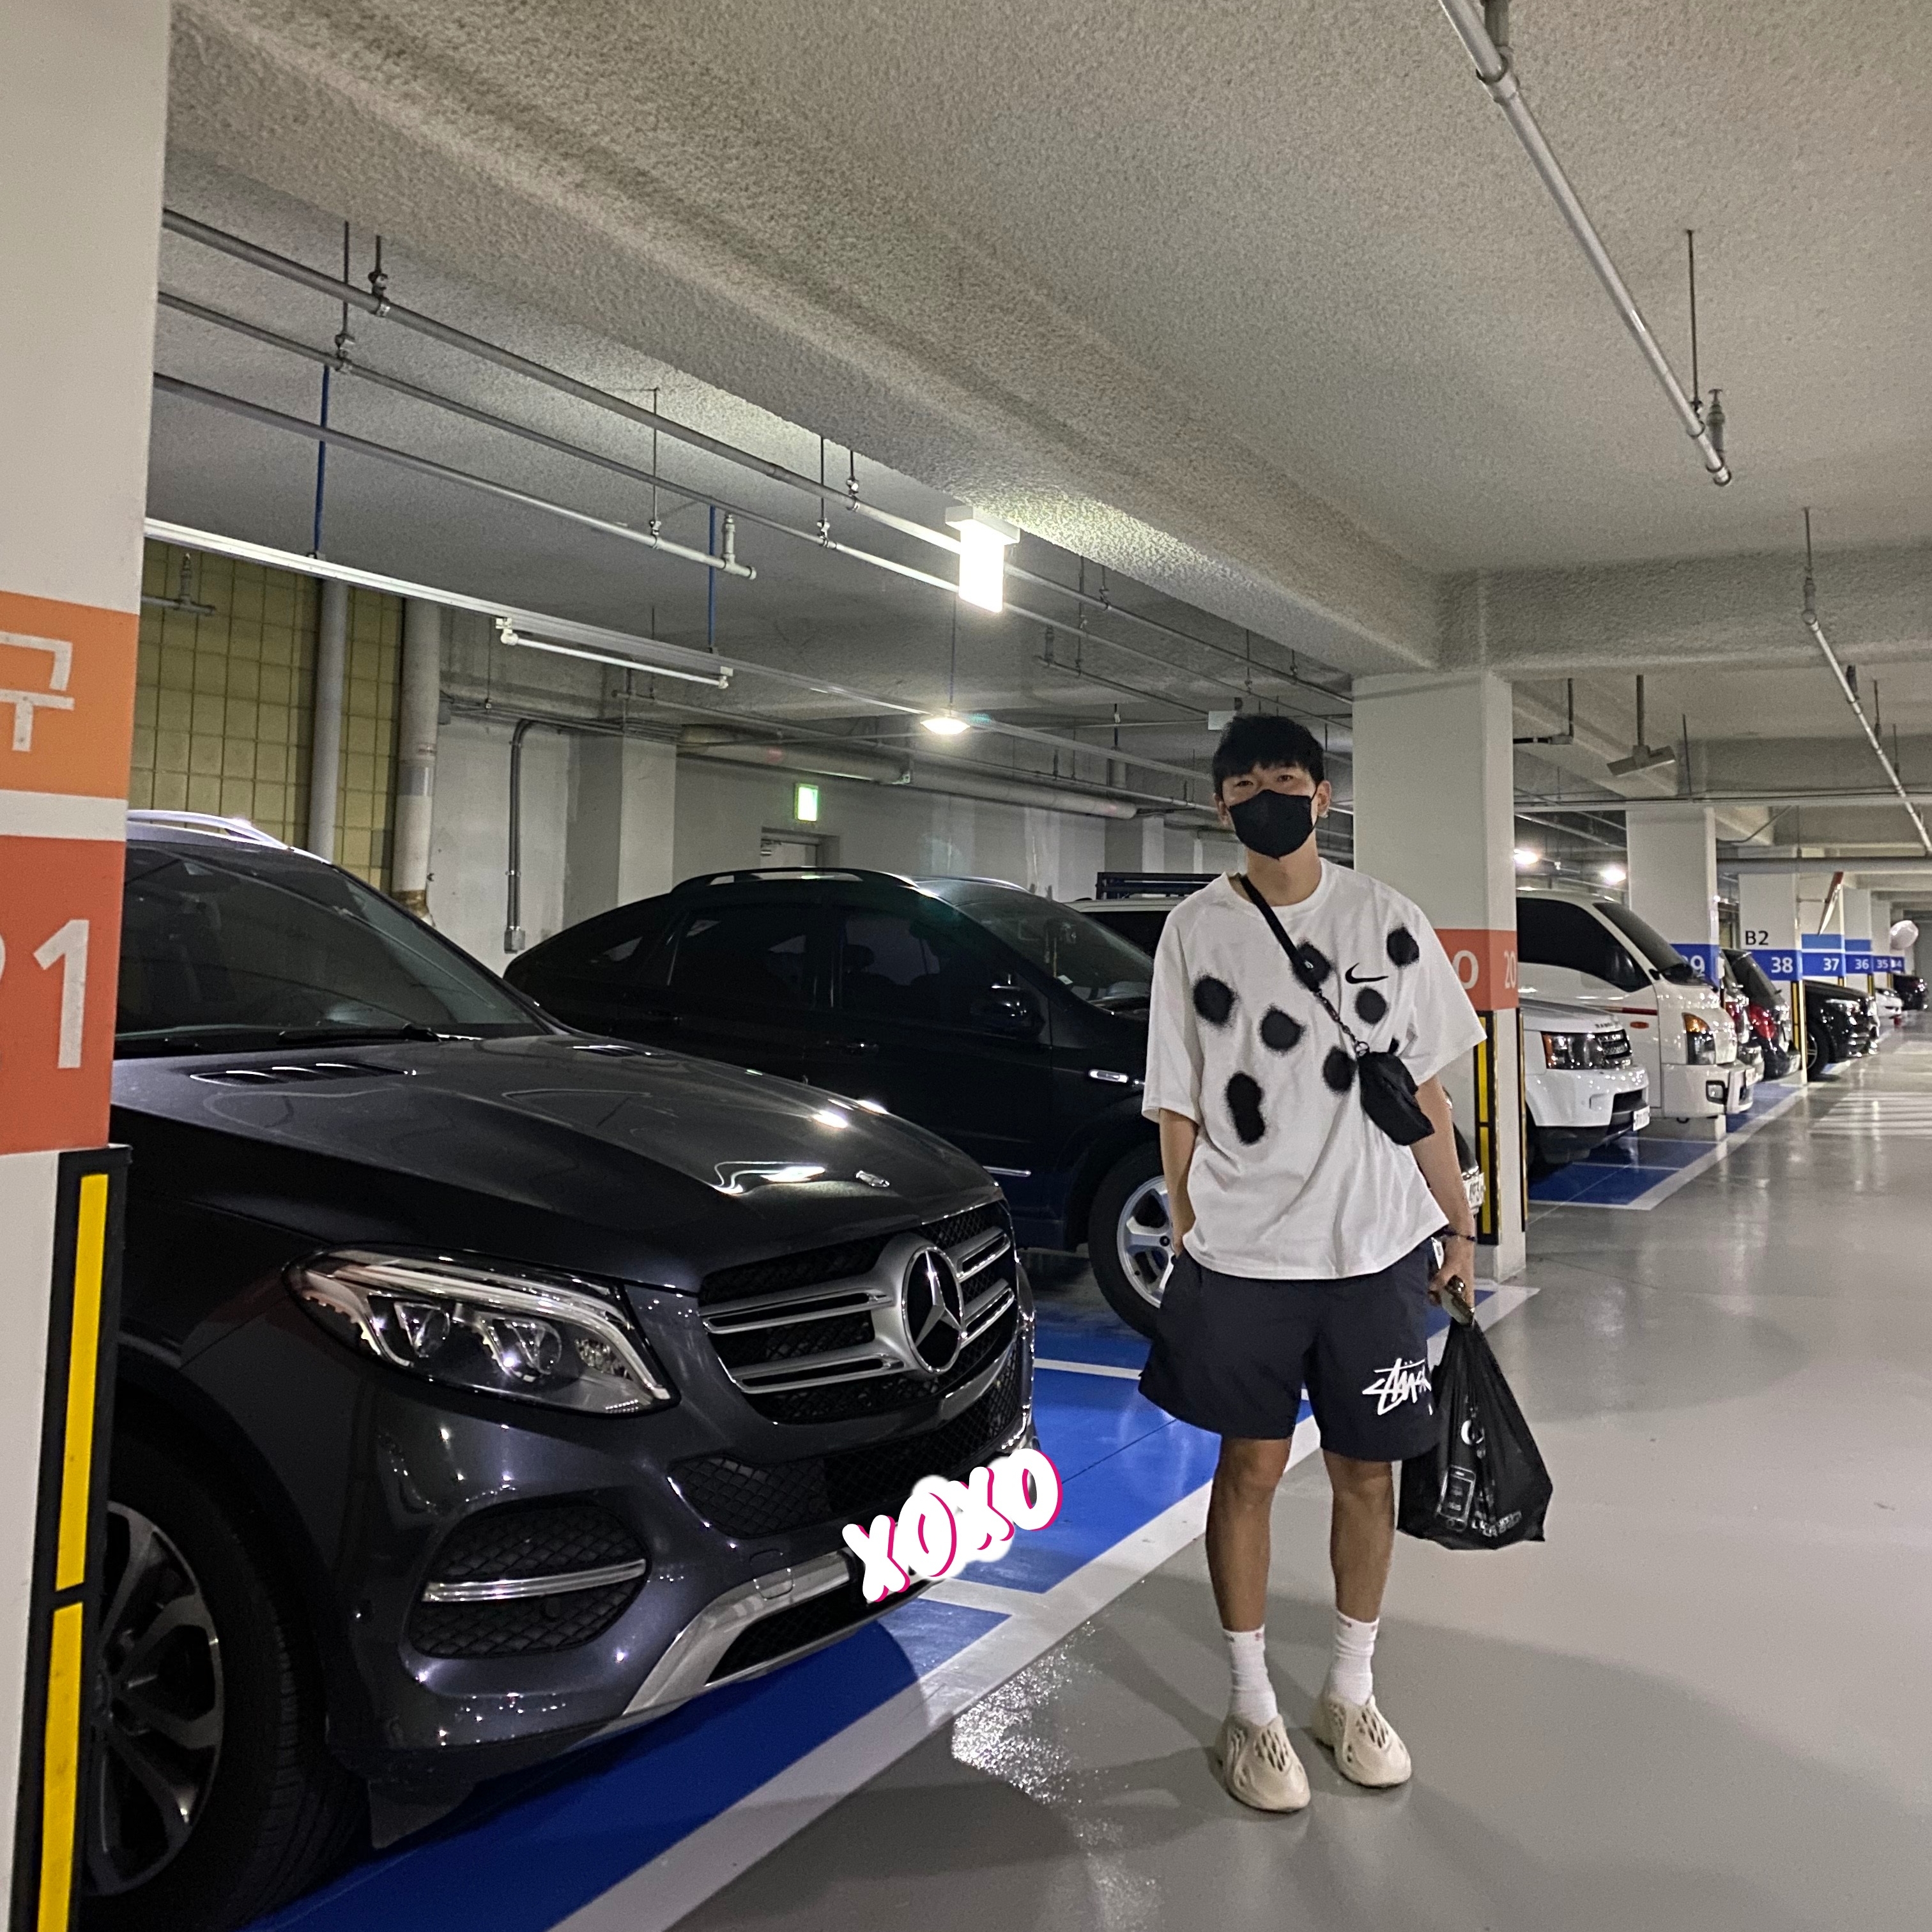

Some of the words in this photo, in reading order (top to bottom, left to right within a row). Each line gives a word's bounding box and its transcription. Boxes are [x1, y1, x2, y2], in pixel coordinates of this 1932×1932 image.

[1745, 930, 1768, 945] B2
[1452, 950, 1479, 990] 0
[1504, 950, 1517, 989] 20
[1682, 955, 1705, 977] 9
[1771, 956, 1793, 973] 38
[1823, 958, 1839, 971] 37
[1855, 959, 1869, 970] 36
[0, 919, 89, 1068] 1
